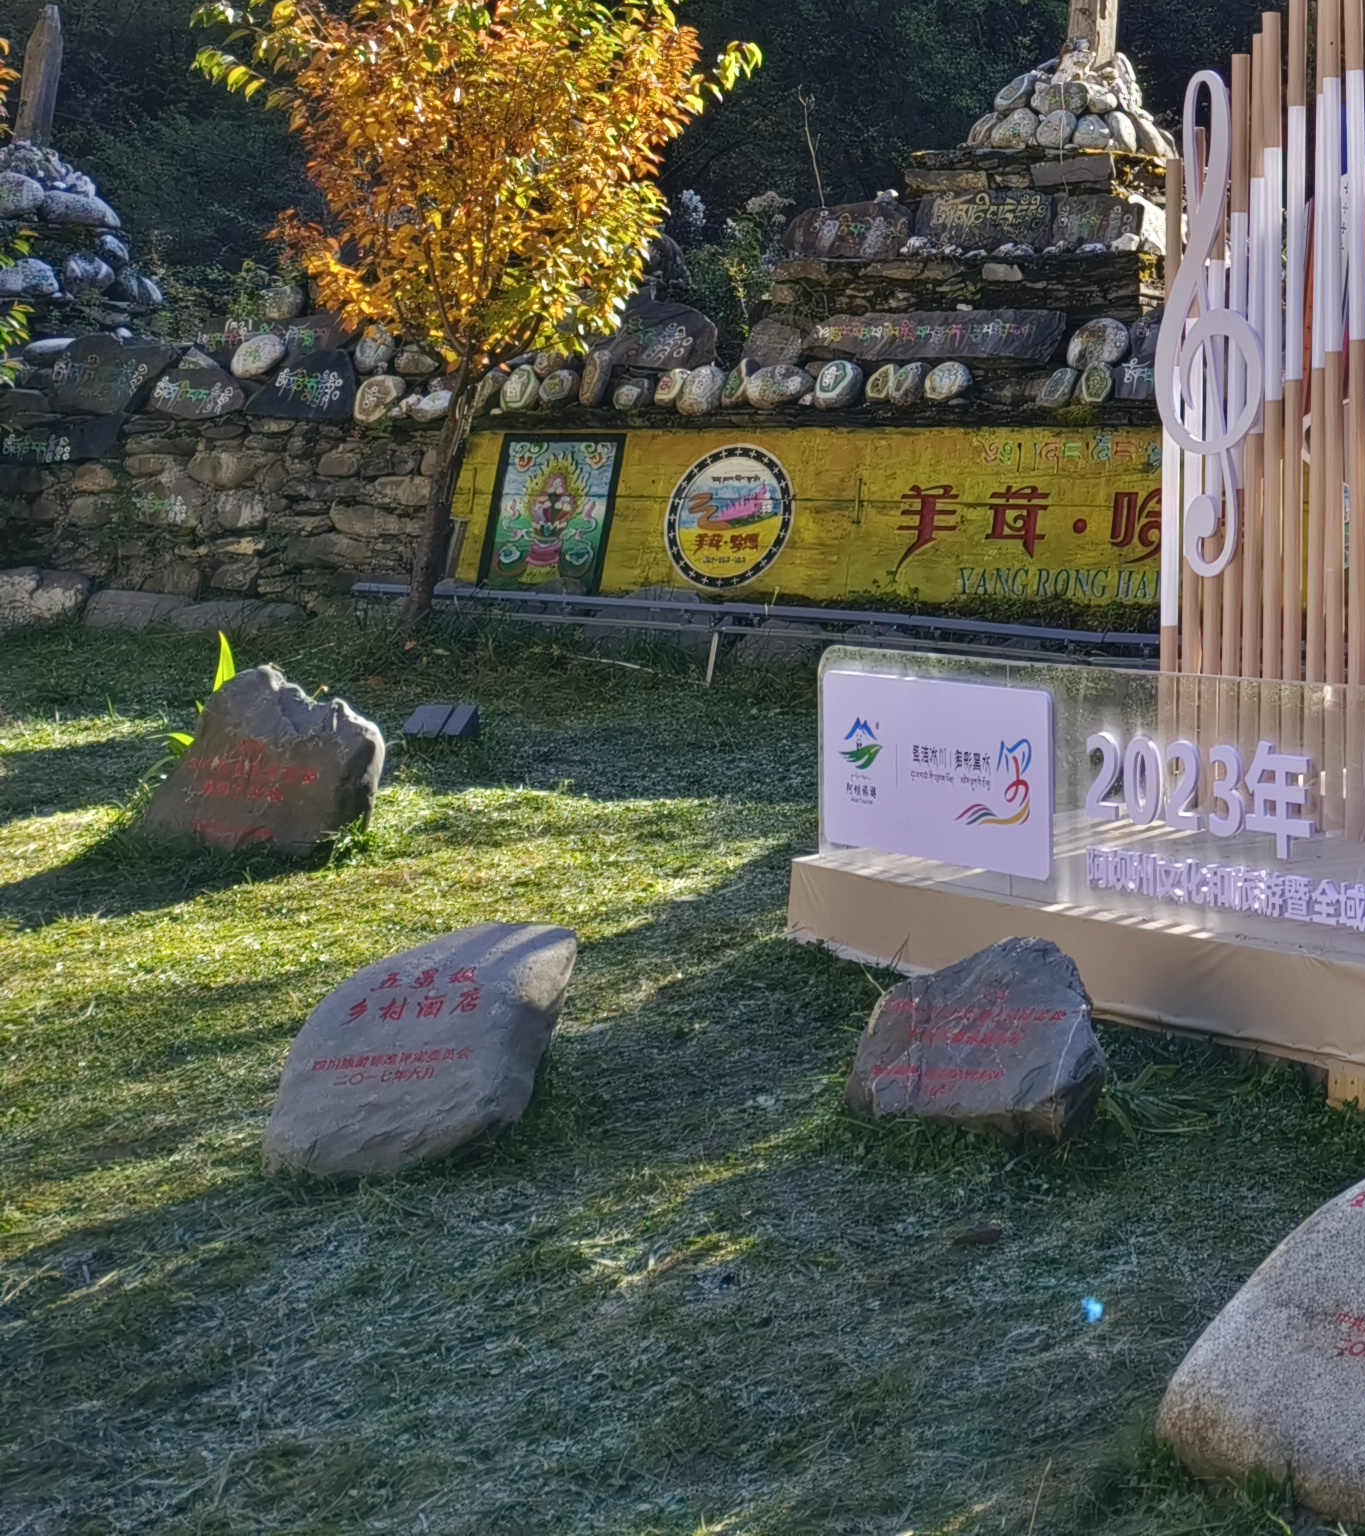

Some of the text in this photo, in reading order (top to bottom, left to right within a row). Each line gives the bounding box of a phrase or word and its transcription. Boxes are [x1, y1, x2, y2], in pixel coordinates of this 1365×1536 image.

[959, 566, 1162, 601] YANG RONG HA
[1085, 731, 1317, 860] 2023年
